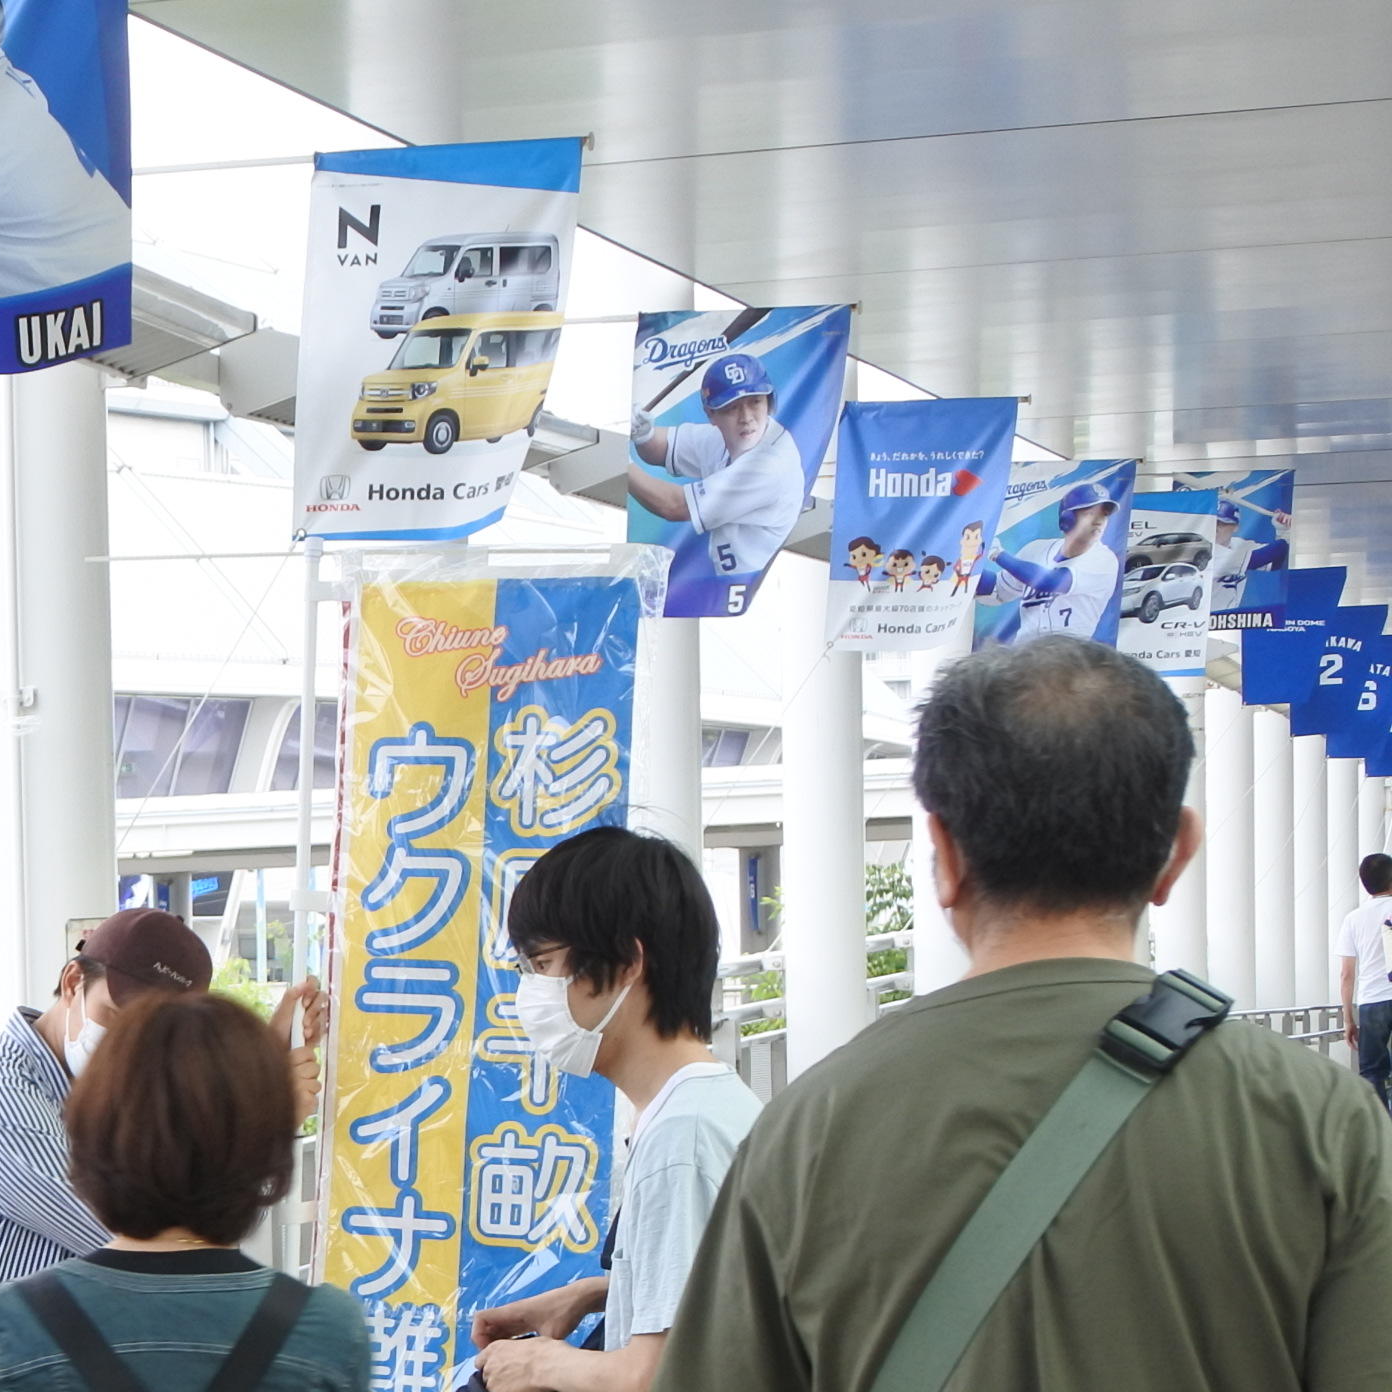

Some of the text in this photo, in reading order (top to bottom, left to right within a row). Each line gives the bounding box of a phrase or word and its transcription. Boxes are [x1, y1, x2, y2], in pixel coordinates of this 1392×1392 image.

[338, 204, 381, 249] N
[337, 252, 378, 267] VAN
[17, 301, 104, 366] UKAI
[643, 335, 729, 371] Dragons
[367, 483, 445, 501] Honda
[452, 481, 490, 500] Cars
[868, 467, 953, 498] Honda
[1005, 479, 1048, 501] ragons
[305, 503, 361, 513] HONDA
[1130, 520, 1158, 530] EL
[717, 544, 738, 571] 5
[727, 585, 747, 614] 5
[876, 622, 922, 635] Honda
[925, 622, 946, 634] Cars
[1058, 607, 1073, 628] 7
[1160, 620, 1207, 630] CR-V
[1297, 619, 1326, 627] DOME
[395, 616, 510, 658] Chiune
[1325, 635, 1363, 652] KAWA
[1128, 650, 1153, 660] nda
[1155, 649, 1181, 660] Cars
[455, 647, 605, 702] Sugihara
[1319, 653, 1344, 686] 2
[473, 710, 616, 1248] 杉千畝
